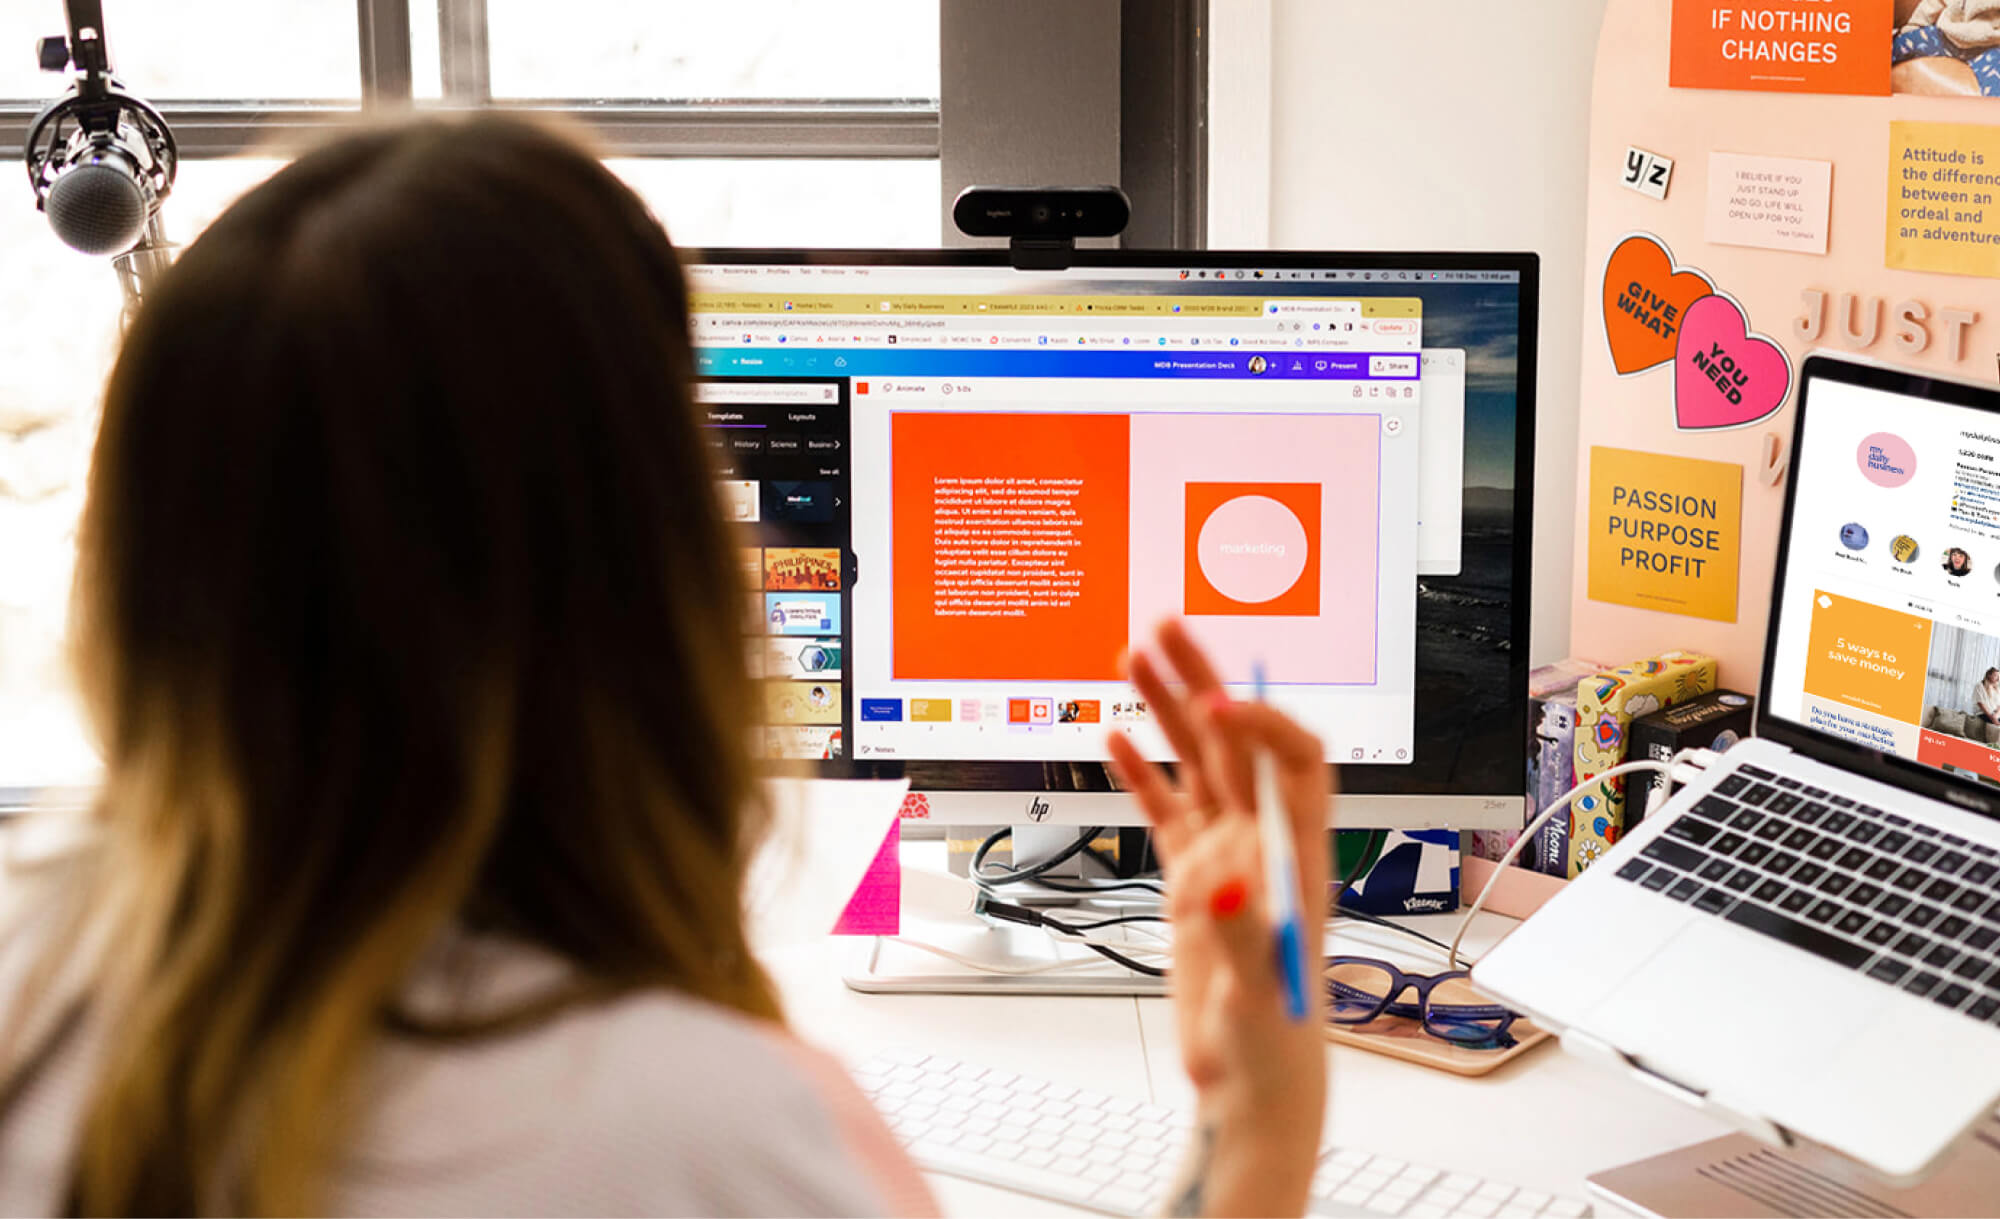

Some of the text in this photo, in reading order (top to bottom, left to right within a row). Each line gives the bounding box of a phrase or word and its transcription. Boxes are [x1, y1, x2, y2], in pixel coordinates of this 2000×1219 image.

[1712, 9, 1851, 34] IF NOTHING
[1722, 40, 1838, 64] CHANGES
[1902, 147, 1984, 165] Attitude is
[1741, 172, 1772, 182] BELIEVE
[1775, 174, 1784, 182] IF
[1785, 174, 1802, 184] YOU
[1902, 166, 1928, 182] the
[1737, 184, 1800, 198] JUST STAND UP
[1902, 185, 1992, 204] between an
[1730, 197, 1748, 206] AND
[1764, 200, 1782, 210] LIFE
[1784, 202, 1804, 212] WILL
[1729, 210, 1802, 224] OPEN UP FOR YOU
[1900, 206, 1983, 224] ordeal and
[1900, 226, 1918, 238] an
[1627, 280, 1678, 320] GIVE
[1616, 292, 1676, 340] WHAT
[1794, 287, 1981, 362] JUST
[1172, 361, 1216, 370] Presentation
[1218, 361, 1235, 370] Deck
[1330, 362, 1358, 370] Present
[1389, 362, 1409, 370] Share
[1710, 341, 1750, 386] YOU
[1692, 350, 1744, 406] NEED
[708, 412, 816, 422] Templates Layouts
[734, 440, 760, 449] History
[770, 440, 798, 448] Science
[960, 477, 982, 486] ipsum
[984, 477, 1004, 485] dolor
[1017, 477, 1037, 486] amet,
[975, 487, 989, 496] elit,
[992, 487, 1004, 495] sed
[1006, 487, 1016, 495] do
[1018, 487, 1050, 495] eiusmod
[1052, 488, 1079, 497] tempor
[975, 497, 981, 505] ut
[983, 497, 1007, 505] labore
[1045, 499, 1070, 507] magna
[1612, 486, 1717, 520] PASSION
[935, 507, 960, 517] aliqua.
[962, 507, 970, 515] Ut
[972, 507, 990, 515] enim
[1060, 508, 1075, 517] quis
[935, 517, 964, 525] nostrud
[1043, 518, 1068, 526] laboris
[1070, 518, 1082, 526] nisi
[935, 527, 942, 535] ut
[1608, 515, 1720, 551] PURPOSE
[1012, 538, 1018, 546] in
[1074, 538, 1080, 546] in
[935, 548, 970, 557] voluptate
[1008, 548, 1030, 556] cillum
[1032, 548, 1056, 556] dolore
[1220, 543, 1286, 557] marketing
[935, 558, 956, 567] fugiat
[978, 558, 1009, 568] pariatur.
[1012, 558, 1049, 568] Excepteur
[1620, 547, 1706, 578] PROFIT
[970, 568, 1005, 578] cupidatat
[935, 578, 955, 588] culpa
[957, 578, 968, 588] qui
[971, 578, 993, 586] officia
[948, 588, 979, 596] laborum
[1060, 589, 1079, 599] culpa
[1836, 638, 1896, 664] 5 ways to
[1828, 650, 1906, 680] save money
[1030, 796, 1049, 822] hp
[1403, 895, 1444, 912] Kleenex
